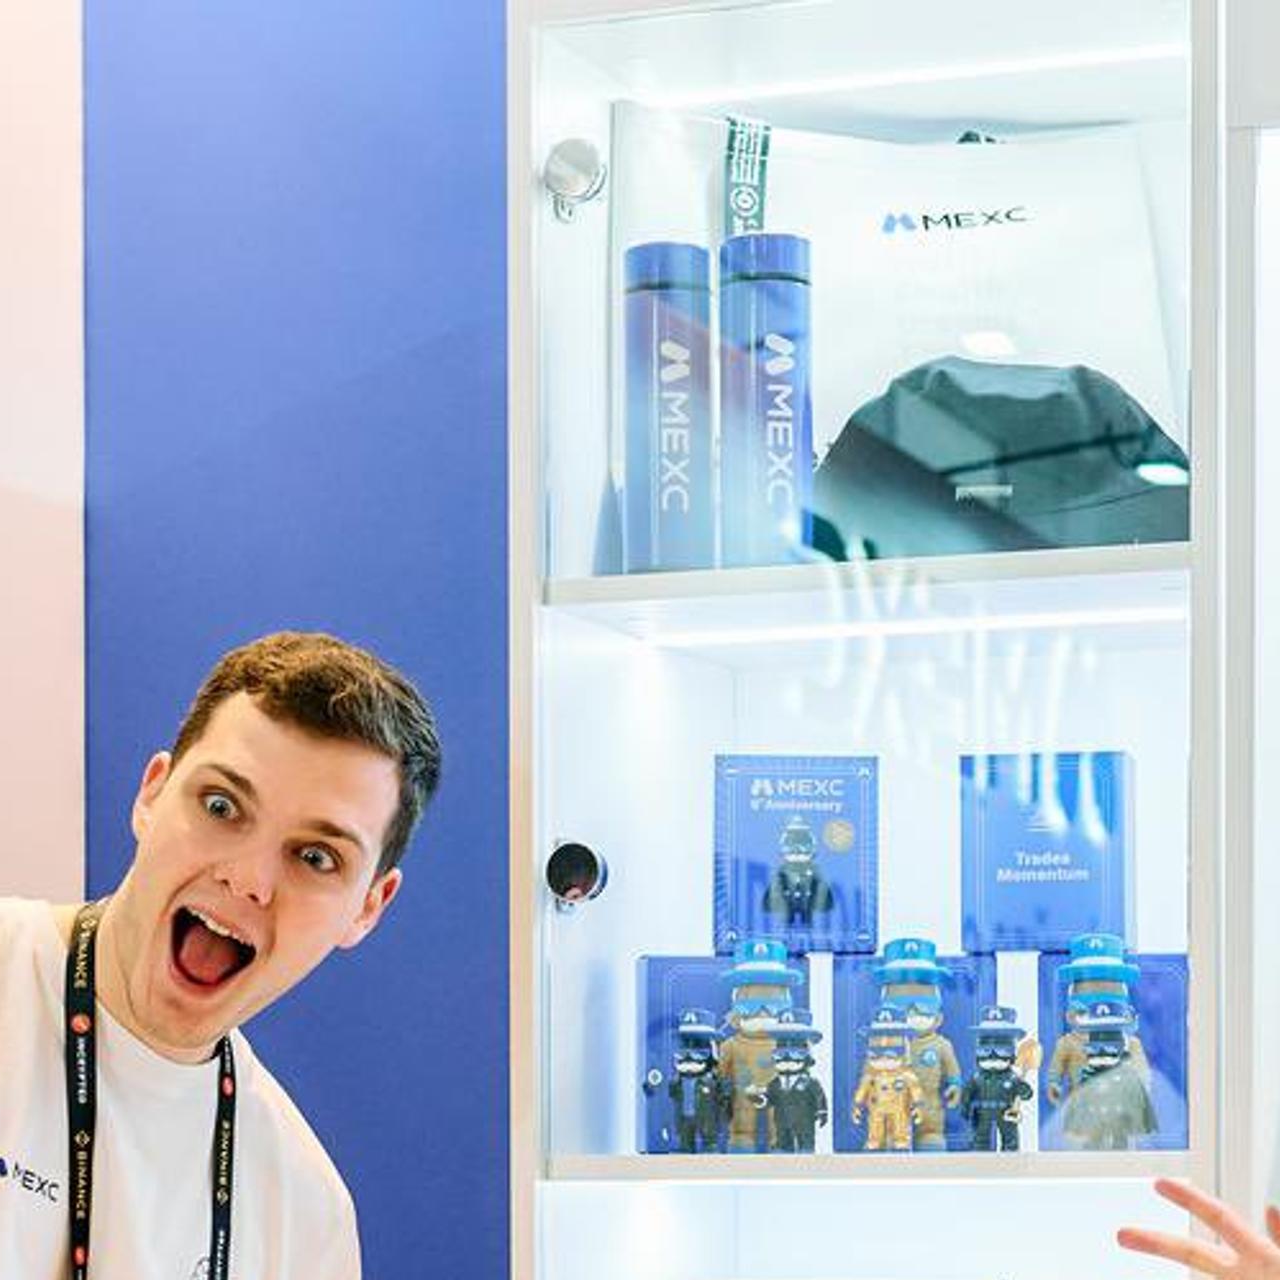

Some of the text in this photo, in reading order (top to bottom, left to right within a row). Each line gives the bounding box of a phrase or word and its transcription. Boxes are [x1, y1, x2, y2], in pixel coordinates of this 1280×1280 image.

[922, 205, 1028, 231] MEXC
[661, 391, 691, 514] MEXC
[767, 384, 793, 503] MEXC
[778, 778, 845, 796] MEXC
[996, 867, 1089, 882] Momentum
[76, 1150, 88, 1219] BINANCE
